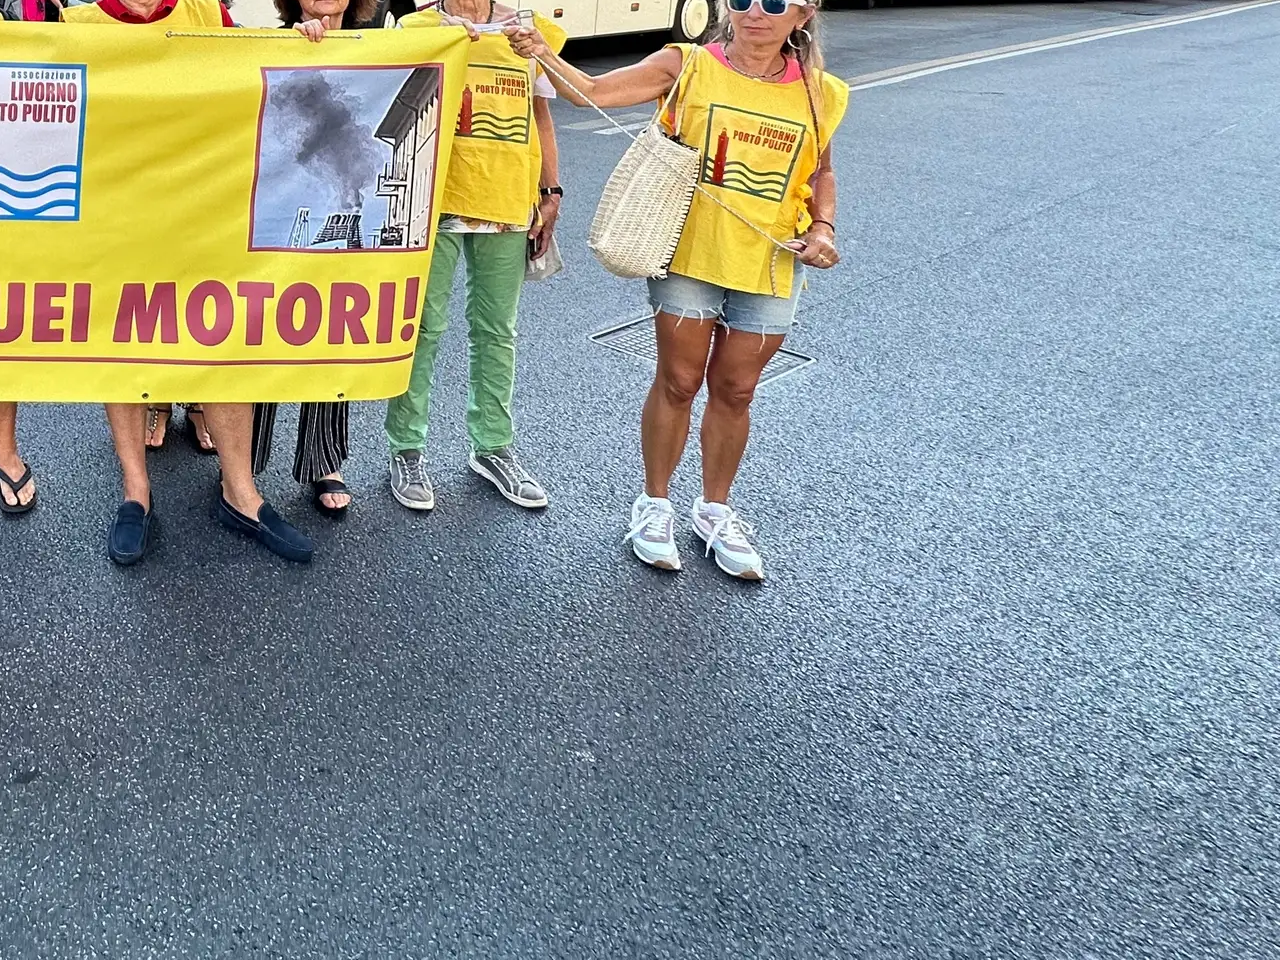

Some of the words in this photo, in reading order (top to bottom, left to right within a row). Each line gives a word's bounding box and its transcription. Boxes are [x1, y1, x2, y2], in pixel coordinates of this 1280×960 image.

[11, 70, 76, 80] associazione
[495, 77, 526, 88] LIVORNO
[10, 81, 77, 103] LIVORNO
[475, 84, 500, 94] PORTO
[501, 86, 526, 98] PULITO
[22, 103, 76, 124] PULITO
[733, 130, 761, 146] PORTO
[762, 137, 793, 153] PULITO
[758, 126, 797, 143] LIVORNO
[112, 276, 420, 346] MOTORI!
